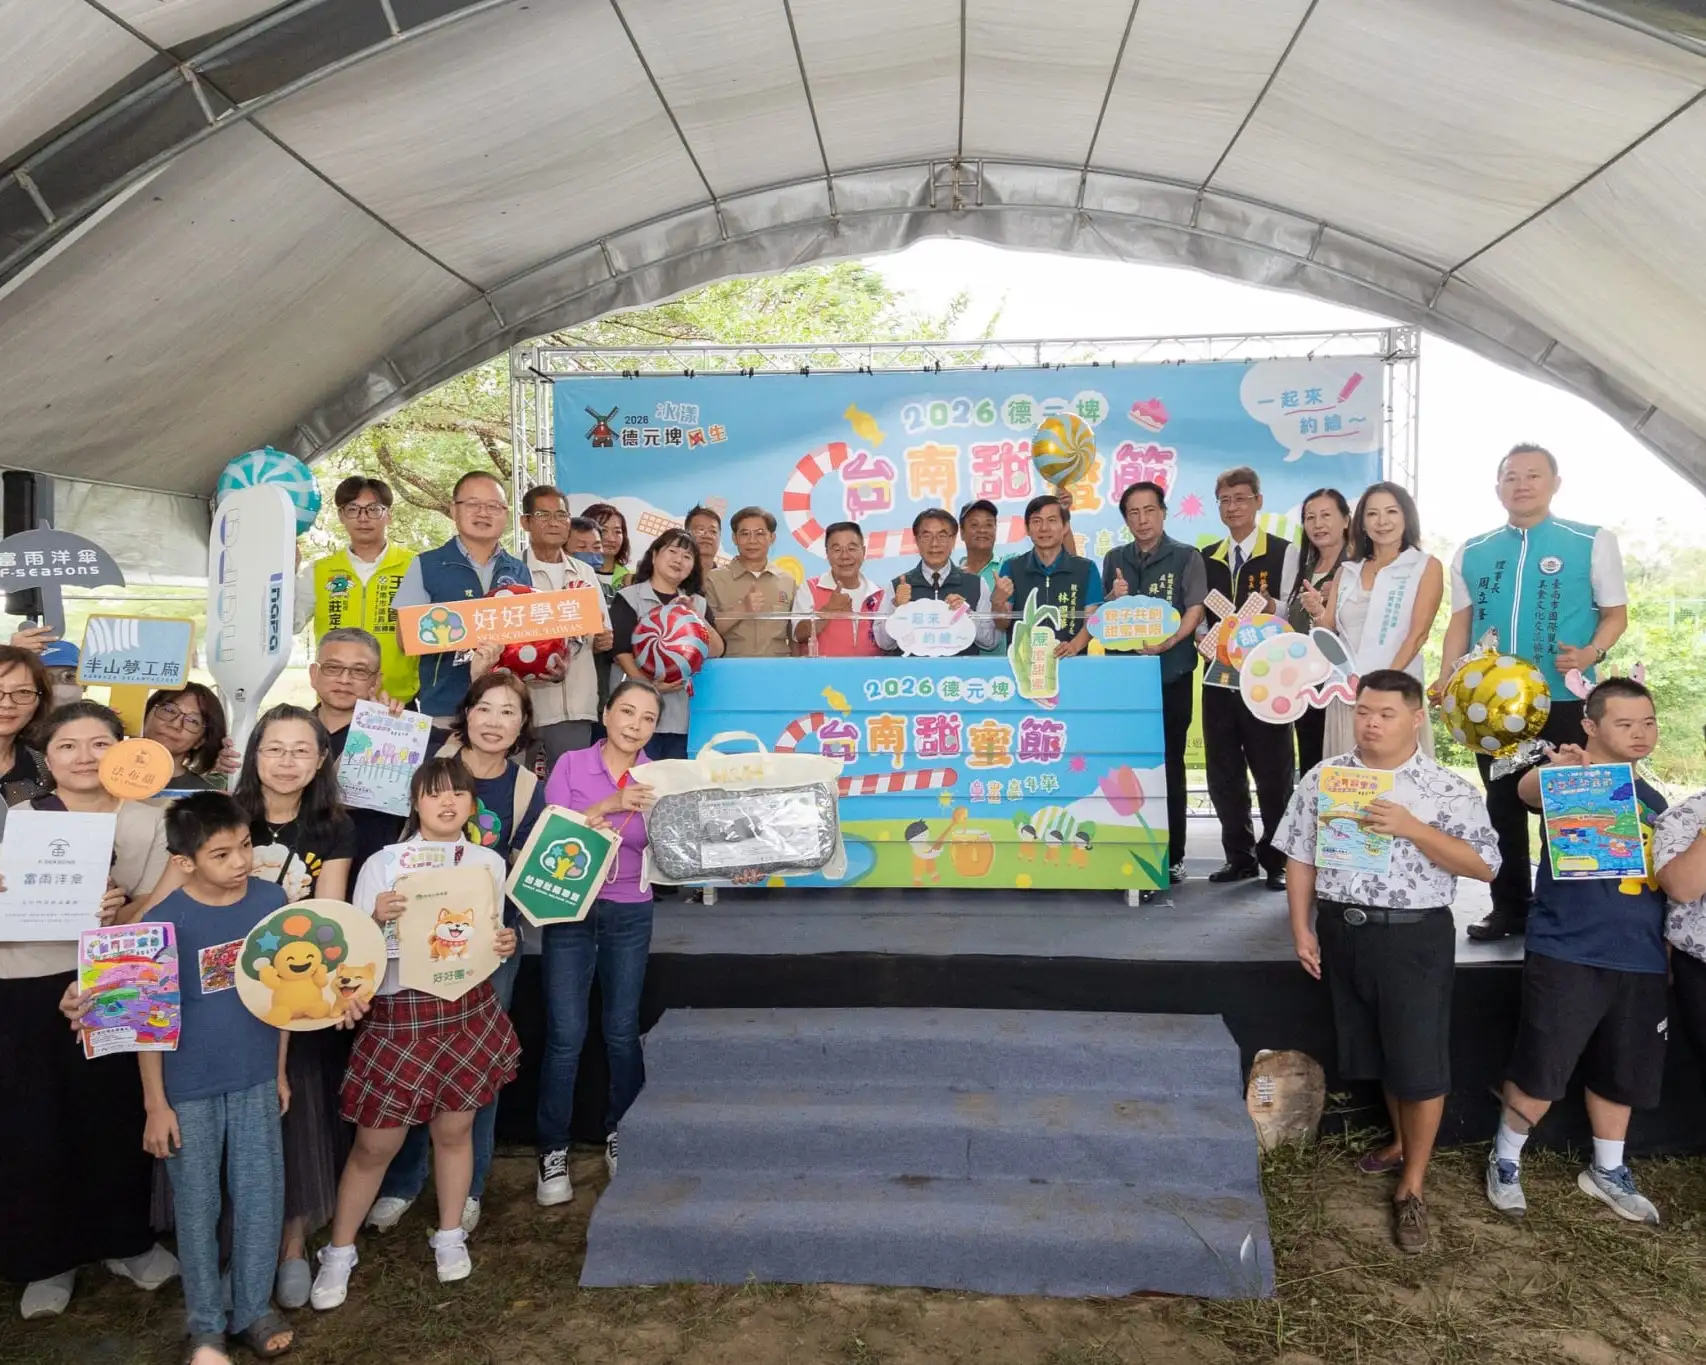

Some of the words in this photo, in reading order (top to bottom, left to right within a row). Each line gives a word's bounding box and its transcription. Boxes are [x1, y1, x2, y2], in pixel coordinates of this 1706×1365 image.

[1257, 388, 1323, 408] 一起來
[903, 400, 995, 431] 2026
[328, 600, 342, 630] 莊定
[471, 599, 583, 632] 好好學堂
[85, 656, 180, 677] 半山夢工廠
[865, 678, 933, 699] 2026
[942, 680, 1009, 699] 德元埤
[819, 714, 1065, 768] 台南甜蜜節
